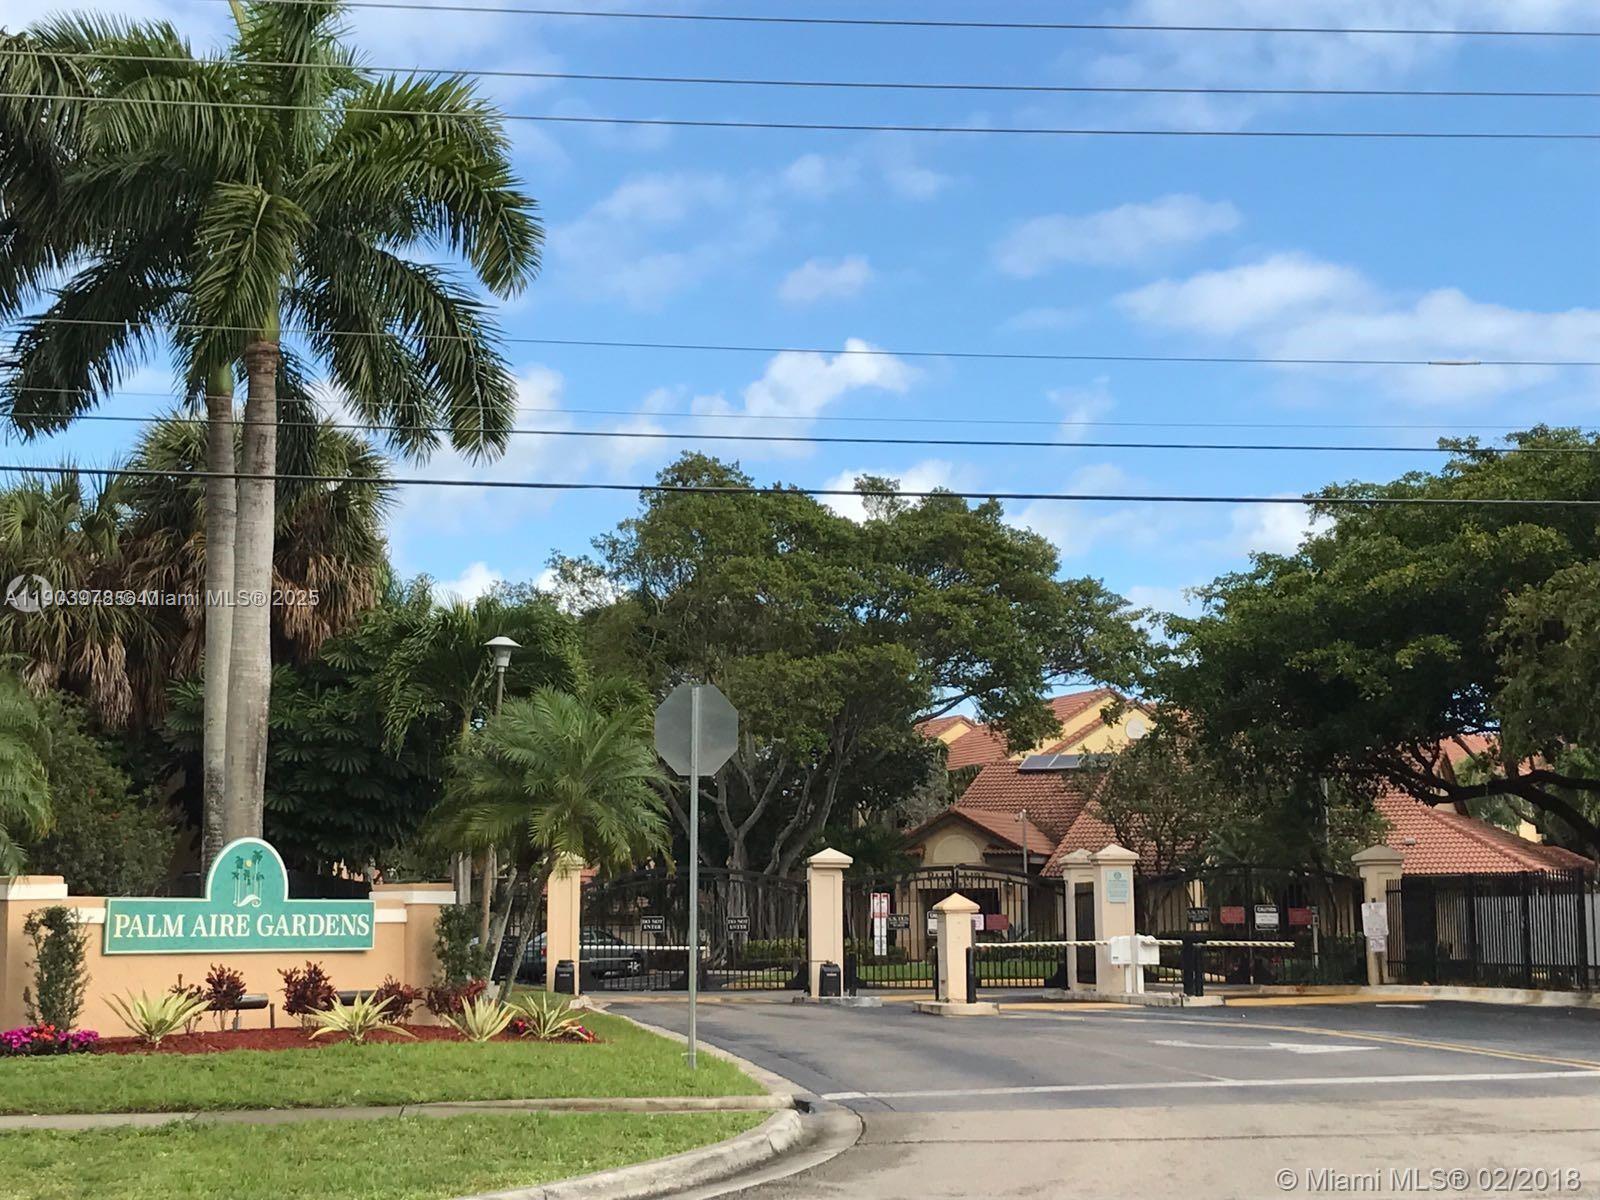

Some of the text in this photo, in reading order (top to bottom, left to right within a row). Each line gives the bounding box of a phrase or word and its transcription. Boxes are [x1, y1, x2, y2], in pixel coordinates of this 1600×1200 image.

[113, 914, 370, 938] PALM AIRE GARDENS
